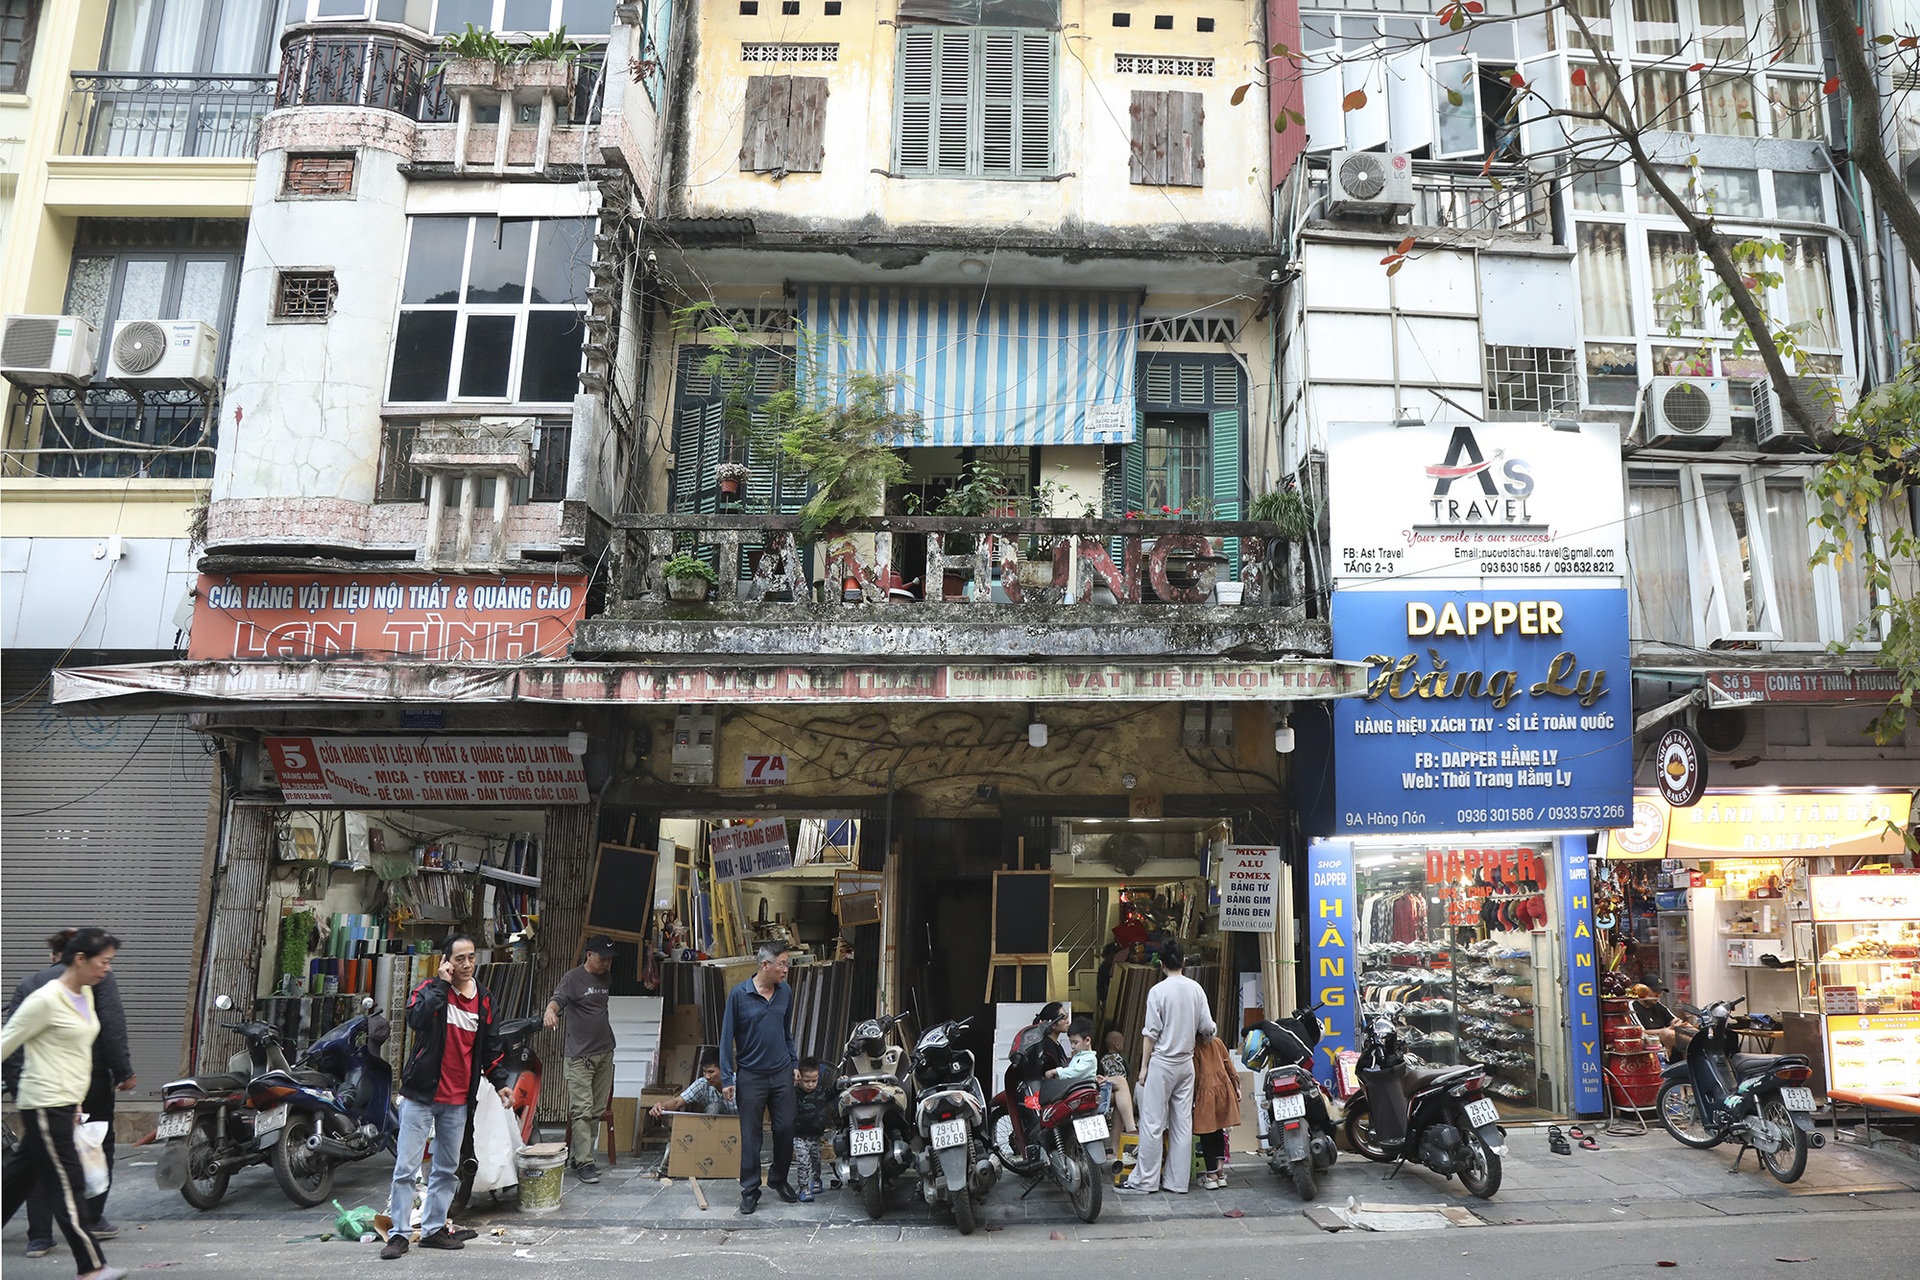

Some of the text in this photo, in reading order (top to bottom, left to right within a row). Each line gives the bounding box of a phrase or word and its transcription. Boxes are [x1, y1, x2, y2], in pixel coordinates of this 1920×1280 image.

[1430, 500, 1532, 519] TRAVEL
[1402, 529, 1436, 547] Your
[1440, 530, 1470, 543] smile
[1474, 532, 1485, 543] is
[1487, 534, 1506, 543] our
[1343, 547, 1404, 559] FB: Ast Travel
[1375, 562, 1393, 573] 2-3
[208, 577, 242, 609] CỬA
[246, 581, 294, 609] HÀNG
[298, 581, 331, 614] VẬT
[332, 581, 371, 614] LIỆU
[372, 581, 405, 614] NỘI
[408, 578, 451, 610] THẤT
[454, 585, 470, 610] &
[473, 577, 532, 612] QUẢNG
[1406, 600, 1564, 637] DAPPER
[234, 612, 539, 661] LAN TÌNH
[1529, 651, 1610, 707] Ly
[1742, 675, 1751, 688] 9
[1768, 672, 1802, 691] CÔNG
[1804, 675, 1818, 690] TY
[1820, 674, 1852, 691] TNHH
[1354, 711, 1615, 736] HÀNG HIỆU XÁCH TAY SỈ LẺ TOÀN QUỐC
[280, 743, 307, 769] 5
[319, 740, 341, 764] CỬA
[341, 744, 371, 764] HÀNG
[371, 743, 390, 766] VẬT
[390, 743, 414, 766] LIỆU
[432, 741, 458, 764] THẤT
[461, 747, 469, 763] &
[470, 740, 505, 765] QUẢNG
[506, 743, 527, 764] CÁO
[528, 745, 549, 764] LAN
[549, 743, 575, 764] TÌNH
[1415, 744, 1559, 769] FB: DAPPER HẰNG LY
[374, 770, 409, 783] MICA
[423, 770, 467, 783] FOMEX
[478, 770, 505, 783] MDF
[517, 765, 534, 783] GỖ
[747, 755, 784, 778] 7A
[325, 768, 371, 798] Chuyên:
[1402, 767, 1572, 789] Web: Thời Trang Hằng Ly
[393, 788, 414, 801] CAN
[422, 785, 443, 801] DÁN
[445, 785, 469, 801] KÍNH
[477, 785, 498, 801] DÁN
[500, 784, 532, 801] TƯỜNG
[534, 785, 554, 800] CÁC
[1666, 785, 1691, 803] BAKERY
[1345, 812, 1363, 826] 9A
[1367, 812, 1399, 827] Hàng
[1402, 811, 1426, 825] Nón
[1691, 801, 1753, 824] BÁNH
[1761, 805, 1787, 823] MÌ
[1793, 802, 1840, 823] TÂM
[764, 824, 785, 843] GHIM
[1743, 833, 1836, 851] BAKERY
[1236, 848, 1267, 856] MICA
[1569, 855, 1585, 864] SHOP
[715, 855, 753, 879] MIKA ALU
[1238, 860, 1264, 868] ALU
[1317, 860, 1342, 869] SHOP
[1425, 848, 1536, 885] DAPPER
[1229, 871, 1271, 880] FOMEX
[1314, 871, 1347, 886] DAPPER
[1569, 868, 1587, 880] DAPPER
[1230, 879, 1270, 892] BẢNG TỪ
[1226, 892, 1271, 904] BẢNG GIM
[1225, 904, 1271, 917] BẢNG ĐEN
[1582, 1062, 1598, 1074] 9A
[1276, 1105, 1304, 1119] 521.51
[855, 1129, 879, 1140] 29-C1
[934, 1132, 966, 1149] 282.69
[852, 1142, 883, 1155] 376.43
